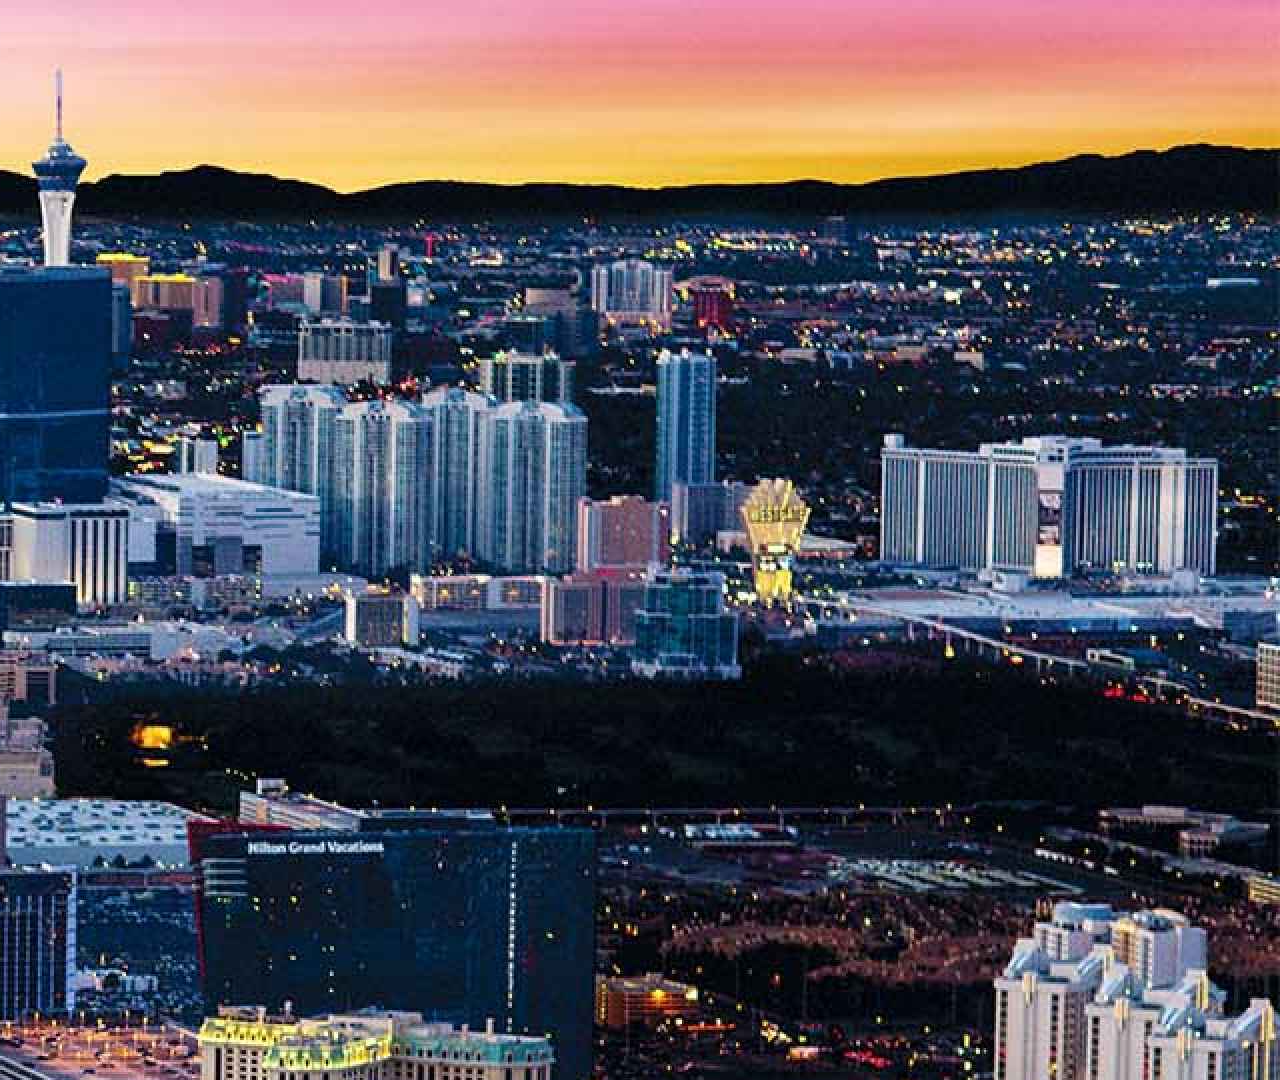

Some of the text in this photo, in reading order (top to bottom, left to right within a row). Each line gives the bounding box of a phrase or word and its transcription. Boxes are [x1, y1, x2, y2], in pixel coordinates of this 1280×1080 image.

[247, 840, 385, 854] Hilton Grand Vacations
